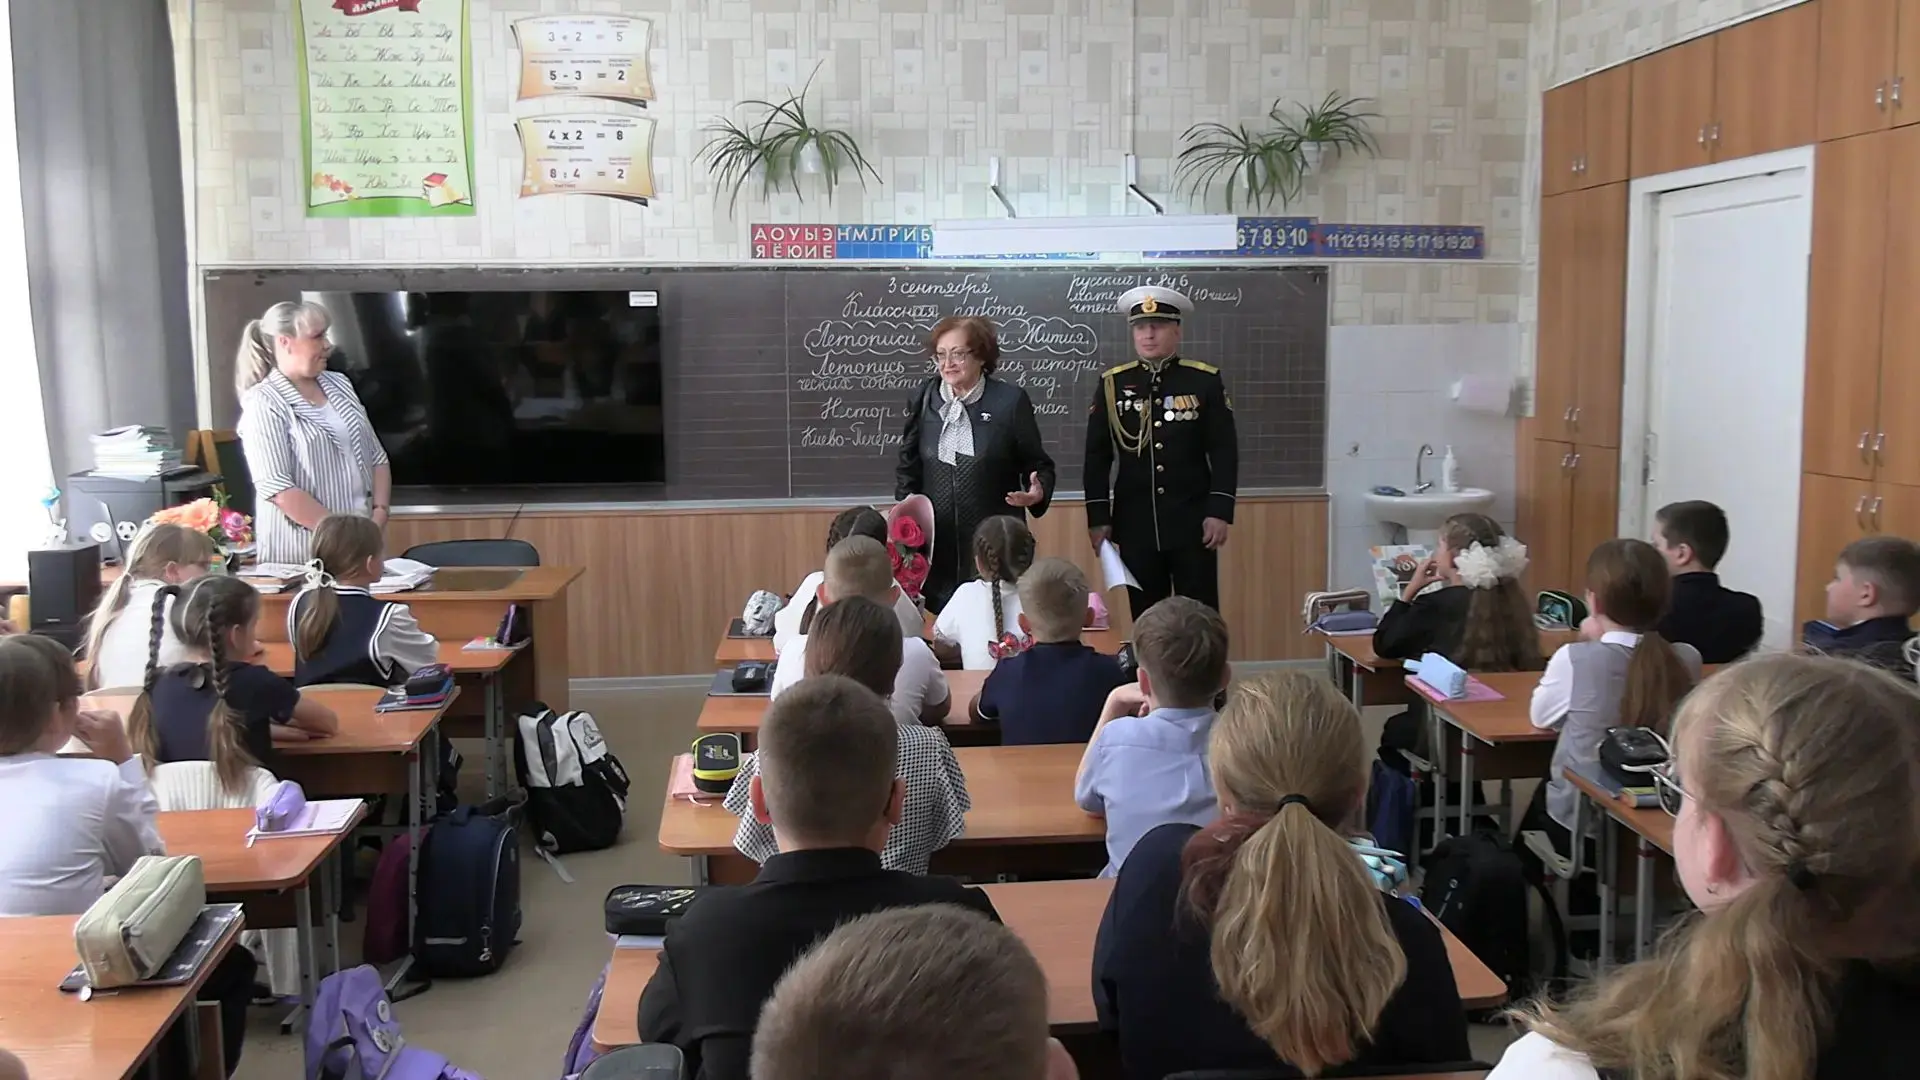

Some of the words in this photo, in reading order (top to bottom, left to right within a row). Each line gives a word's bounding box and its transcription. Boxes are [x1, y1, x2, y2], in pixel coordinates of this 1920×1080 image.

[549, 32, 555, 42] 3
[576, 32, 582, 42] 2
[617, 32, 623, 42] 5
[550, 71, 556, 80] 5
[575, 71, 581, 80] 3
[618, 70, 625, 80] 2
[549, 130, 556, 140] 4
[576, 130, 582, 140] 2
[617, 130, 623, 140] 8
[550, 168, 556, 178] 8
[574, 168, 580, 178] 4
[617, 169, 624, 179] 2
[1237, 229, 1245, 246] 6
[1250, 229, 1259, 246] 7
[1263, 228, 1272, 246] 8
[1276, 228, 1286, 246] 9
[1290, 228, 1308, 246] 10
[1326, 234, 1339, 247] 11
[1340, 234, 1354, 248] 12
[1356, 234, 1369, 248] 13
[1371, 234, 1385, 248] 14
[1386, 235, 1400, 248] 15
[1401, 235, 1415, 249] 16
[1417, 235, 1430, 249] 17
[1431, 235, 1444, 249] 18
[1445, 235, 1458, 249] 19
[1460, 236, 1475, 249] 20
[888, 276, 897, 294] 3
[1069, 303, 1118, 313] чтени
[812, 352, 905, 376] Летопись
[798, 375, 853, 391] ческих
